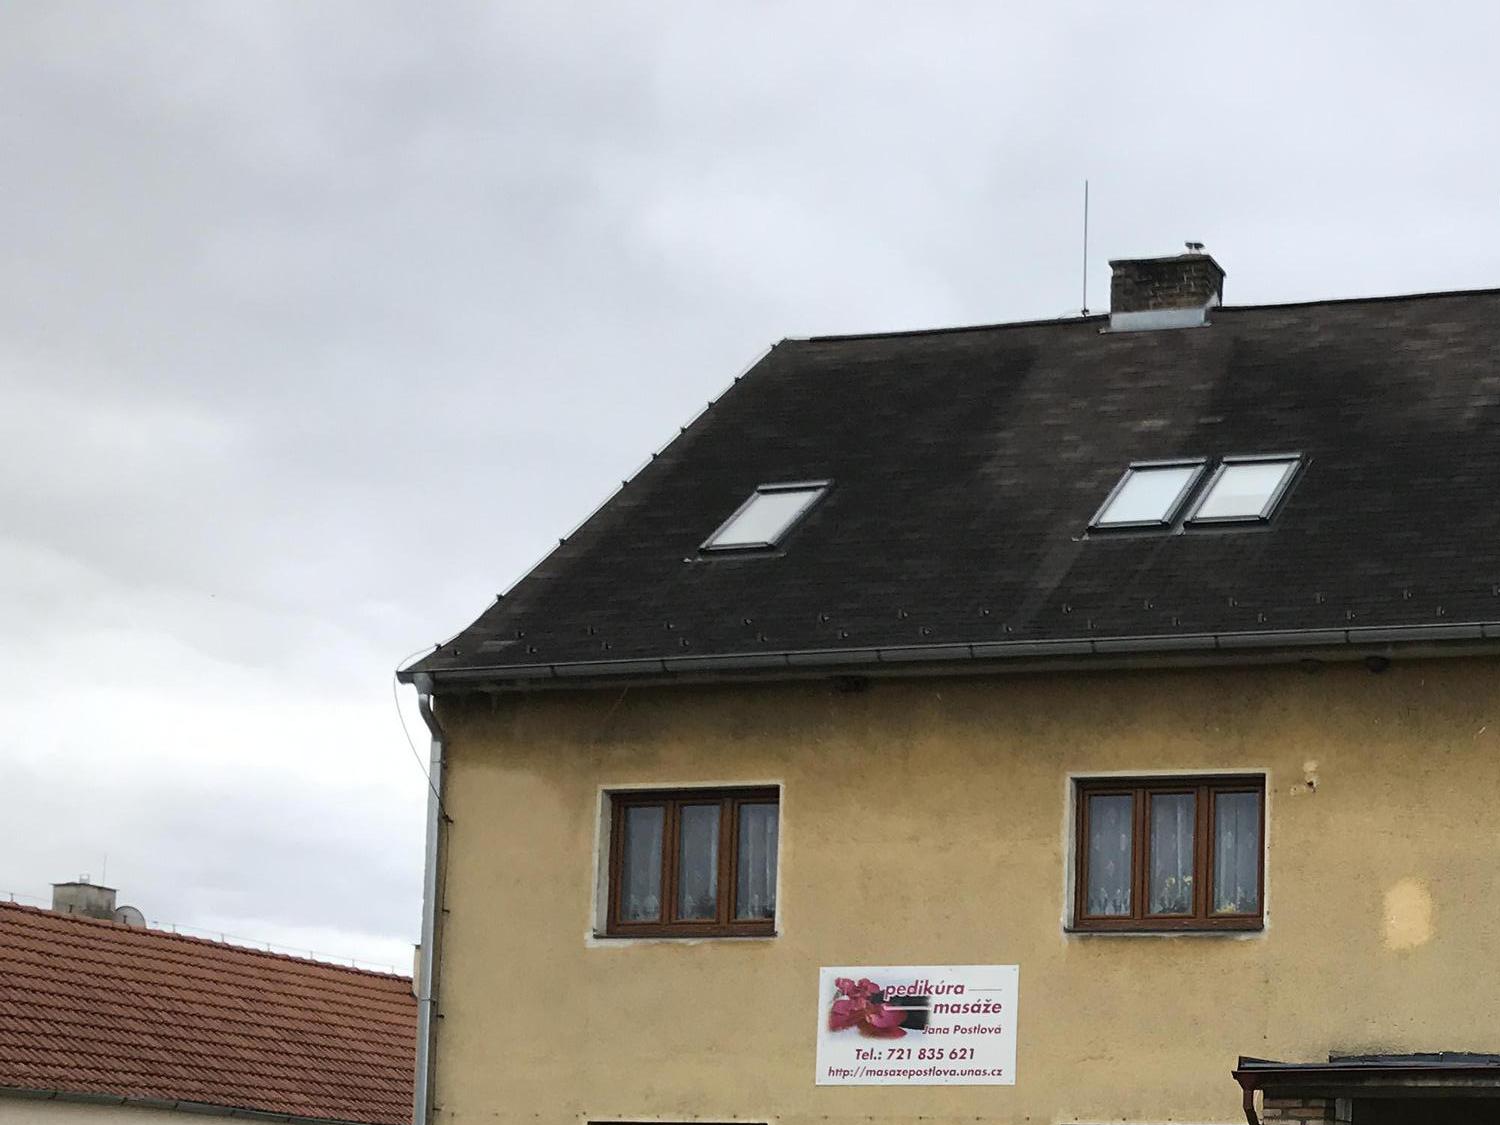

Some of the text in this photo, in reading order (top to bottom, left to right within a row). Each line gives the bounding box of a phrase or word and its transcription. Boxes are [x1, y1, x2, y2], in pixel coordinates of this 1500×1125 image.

[885, 979, 965, 1000] pedikúra
[933, 999, 1002, 1014] masáže
[922, 1025, 1001, 1035] Jana Postlová
[855, 1048, 975, 1060] Tel.: 721 835 621
[828, 1066, 1003, 1079] http://masazepostlova.unas.cz
